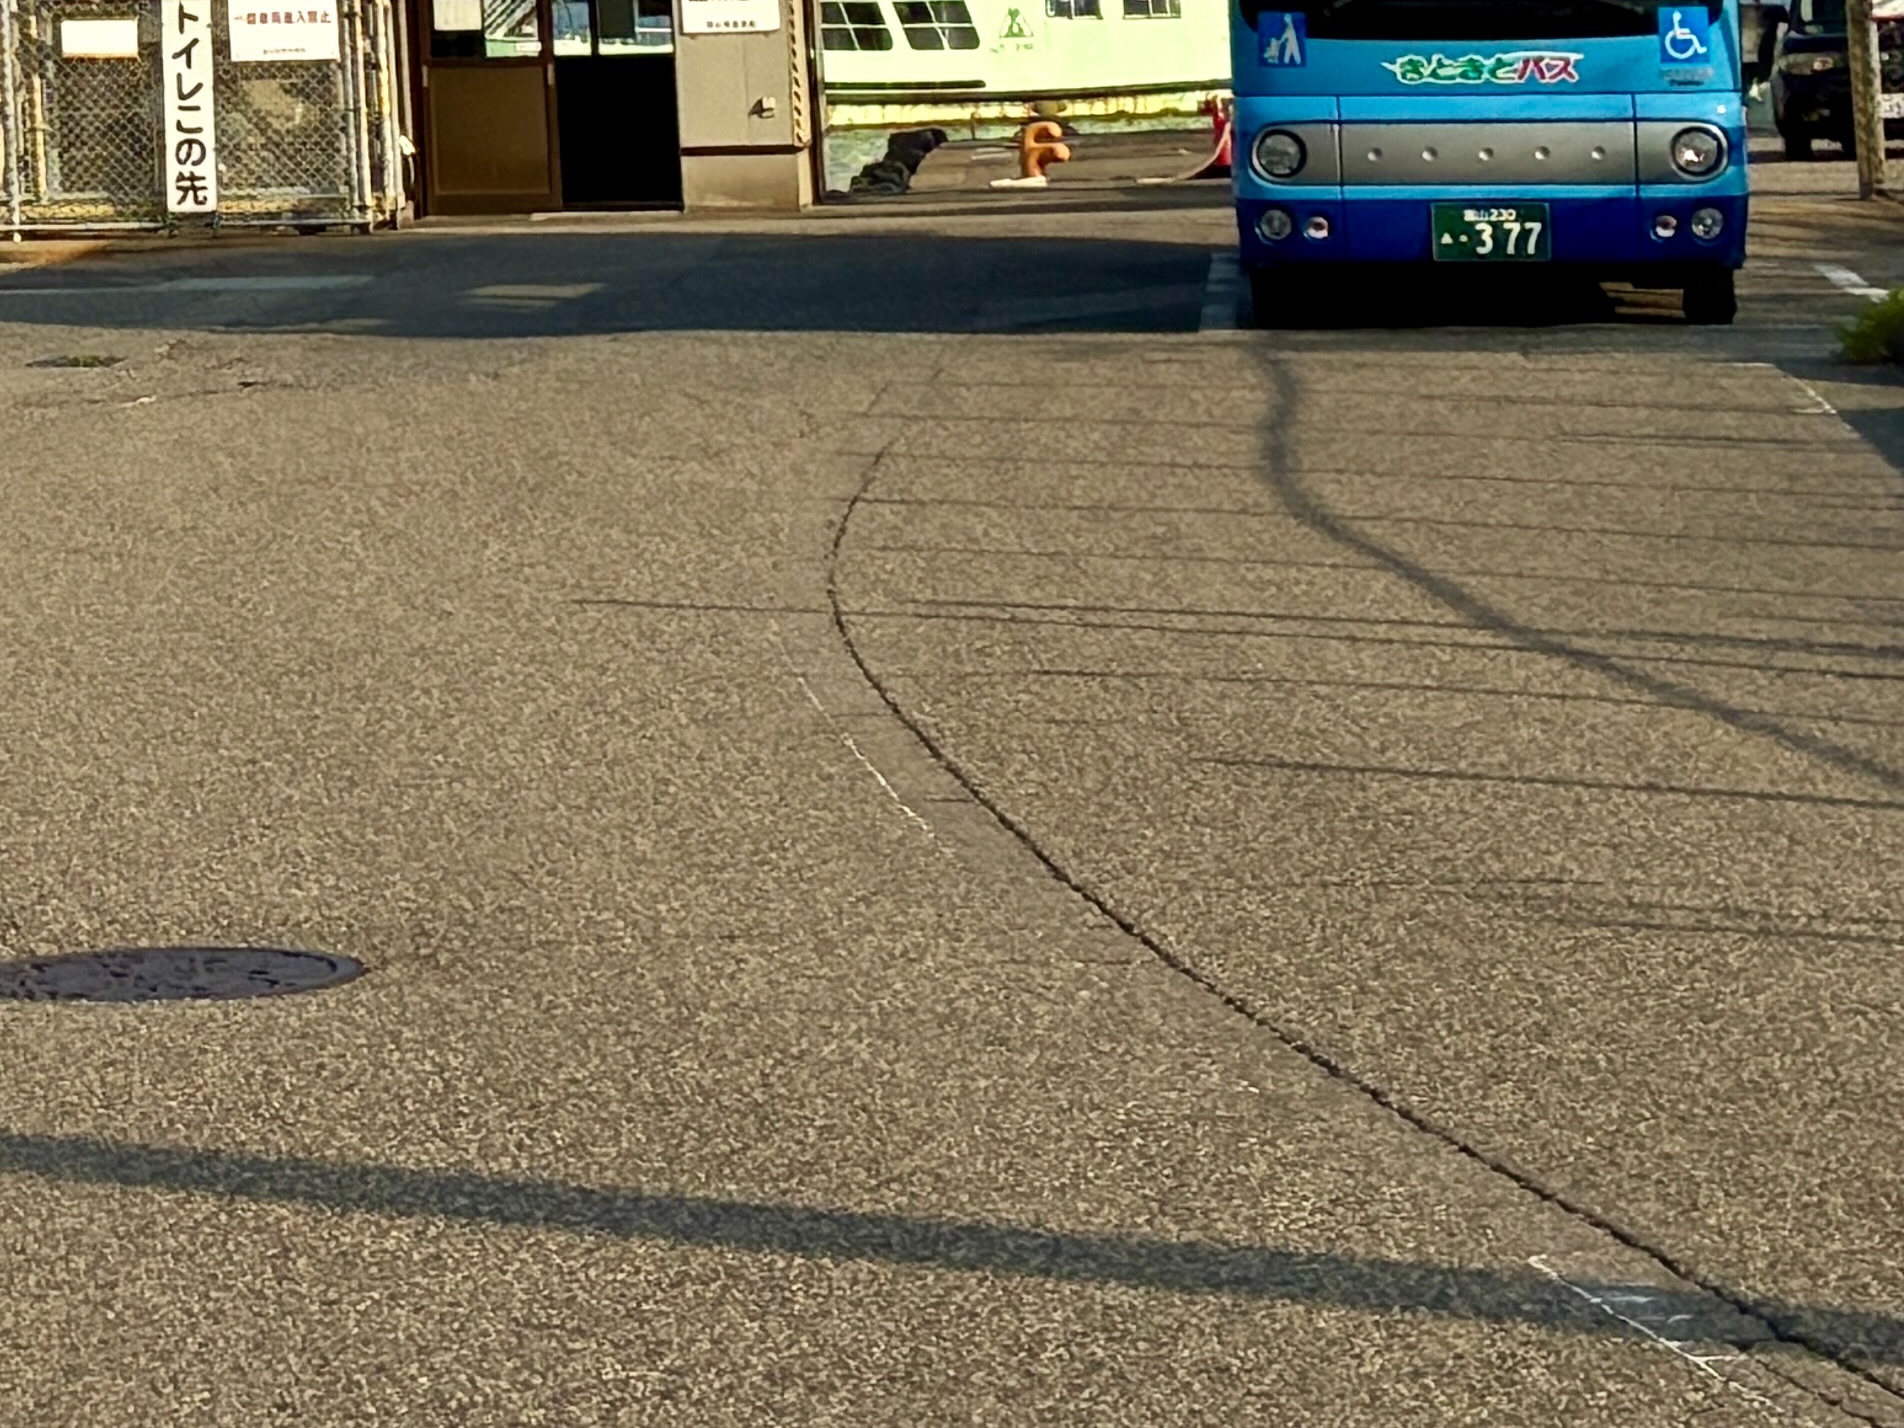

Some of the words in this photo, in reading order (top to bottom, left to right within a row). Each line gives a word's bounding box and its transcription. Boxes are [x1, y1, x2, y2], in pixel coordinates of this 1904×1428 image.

[171, 0, 209, 207] トイレこの先
